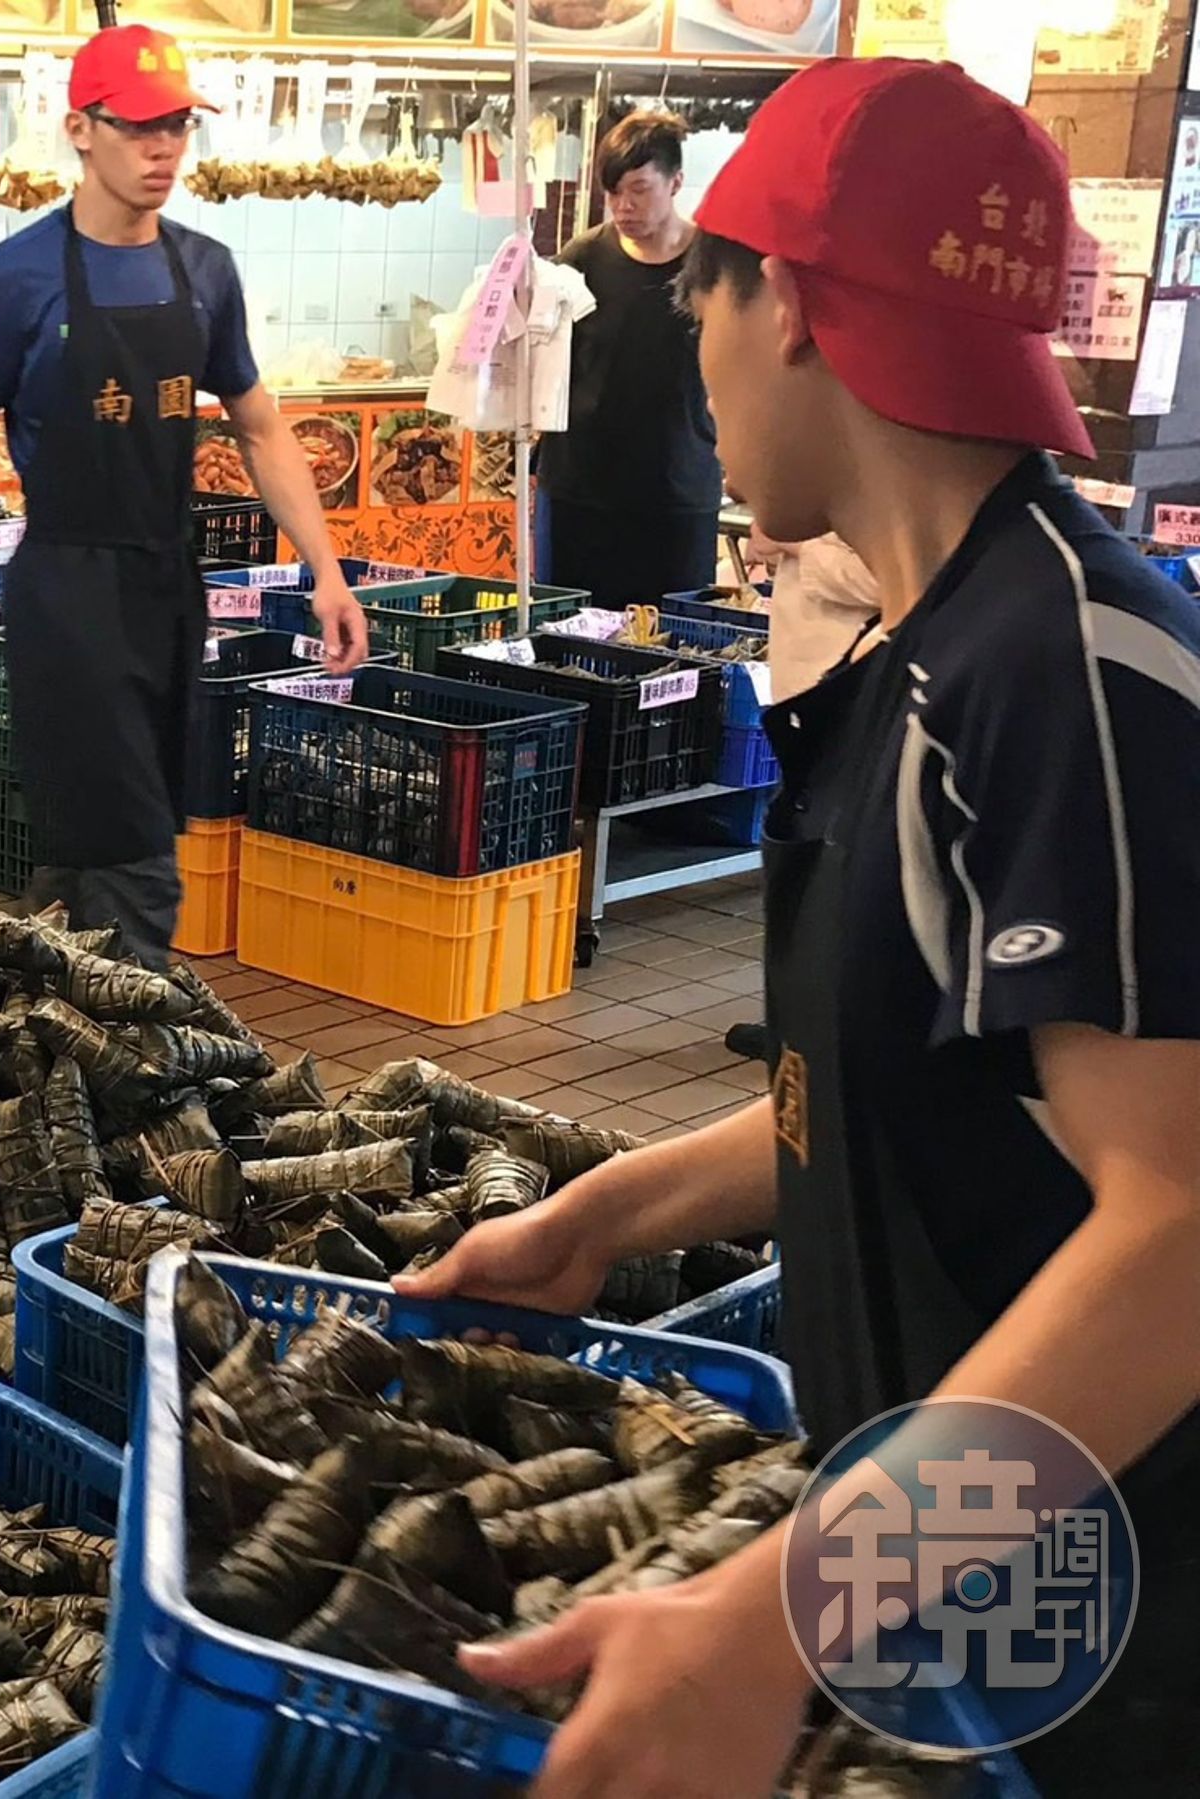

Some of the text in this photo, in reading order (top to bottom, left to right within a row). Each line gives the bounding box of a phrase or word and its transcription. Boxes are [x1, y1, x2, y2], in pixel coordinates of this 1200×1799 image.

[928, 229, 1056, 308] 南門市場
[92, 376, 193, 423] 南園
